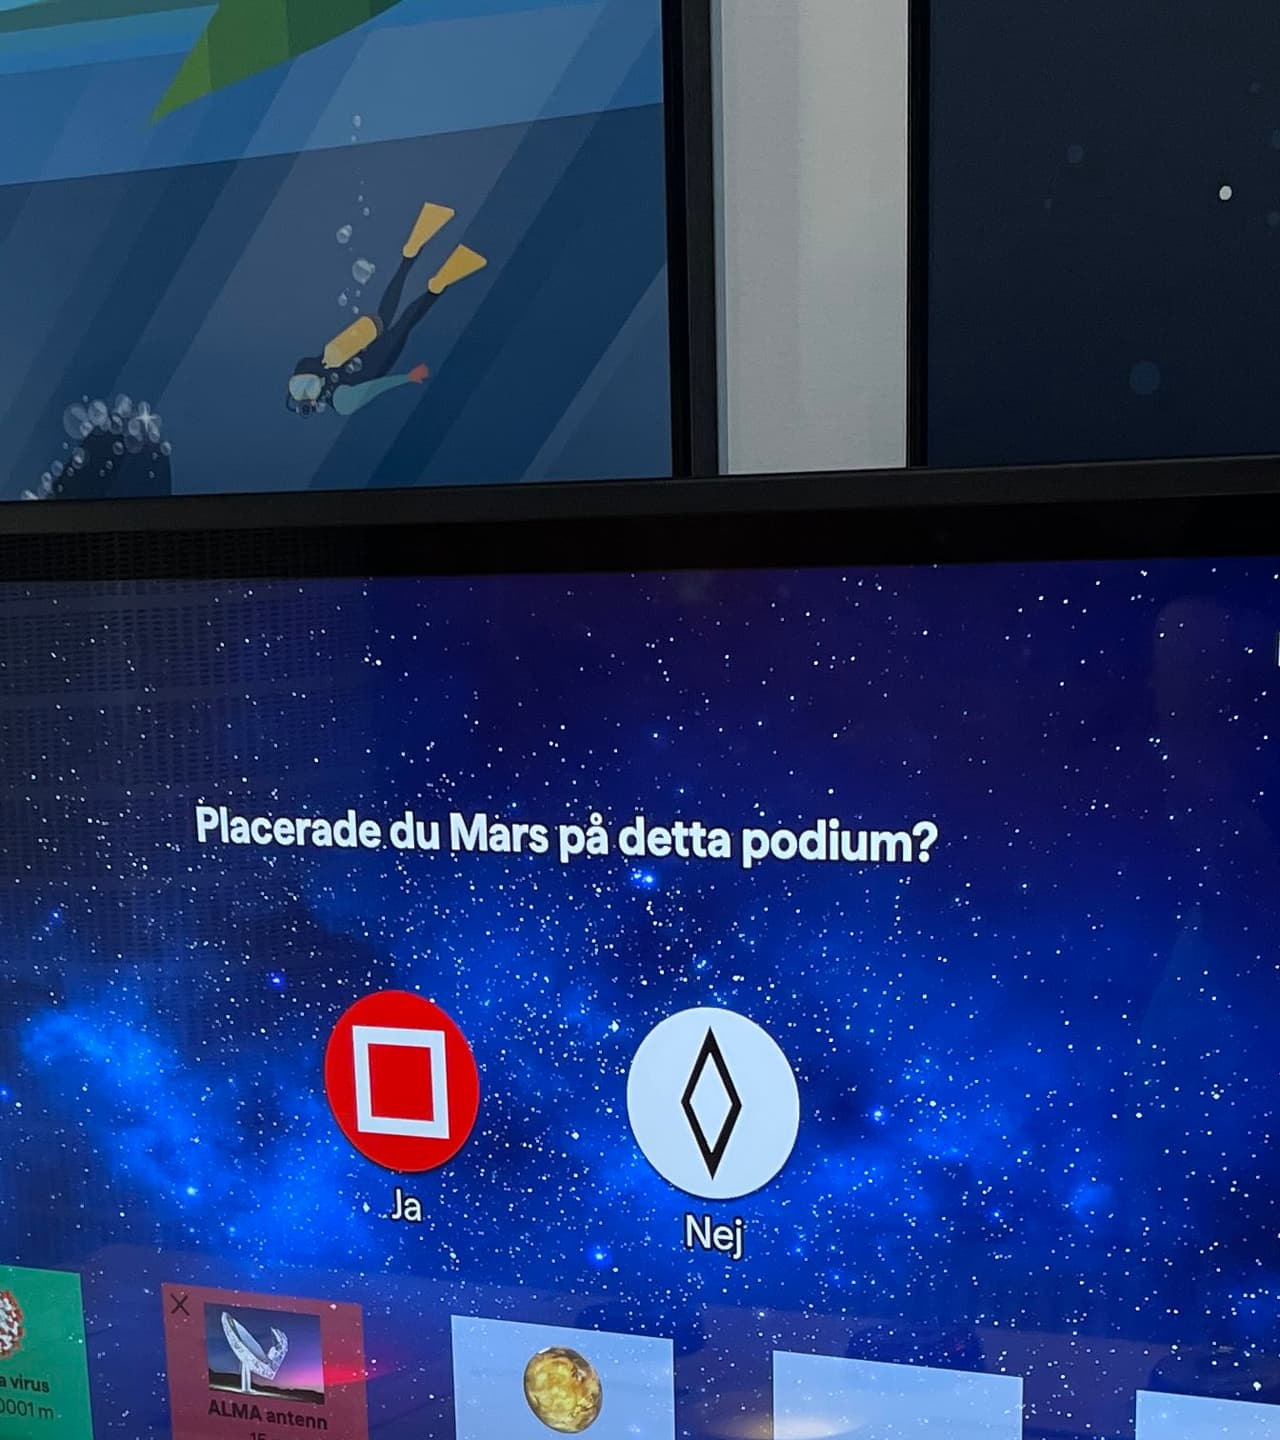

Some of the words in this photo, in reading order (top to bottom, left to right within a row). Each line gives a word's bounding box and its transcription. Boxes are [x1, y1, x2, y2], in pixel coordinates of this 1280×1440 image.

[195, 806, 382, 850] Placerade
[390, 811, 440, 850] du
[449, 812, 549, 854] Mars
[559, 812, 609, 863] på
[618, 816, 731, 859] detta
[742, 818, 939, 869] podium?
[392, 1187, 422, 1222] Ja
[684, 1216, 744, 1260] Nej
[10, 1374, 50, 1393] virus
[39, 1407, 54, 1420] m
[208, 1400, 263, 1422] ALMA
[266, 1410, 328, 1430] antenn
